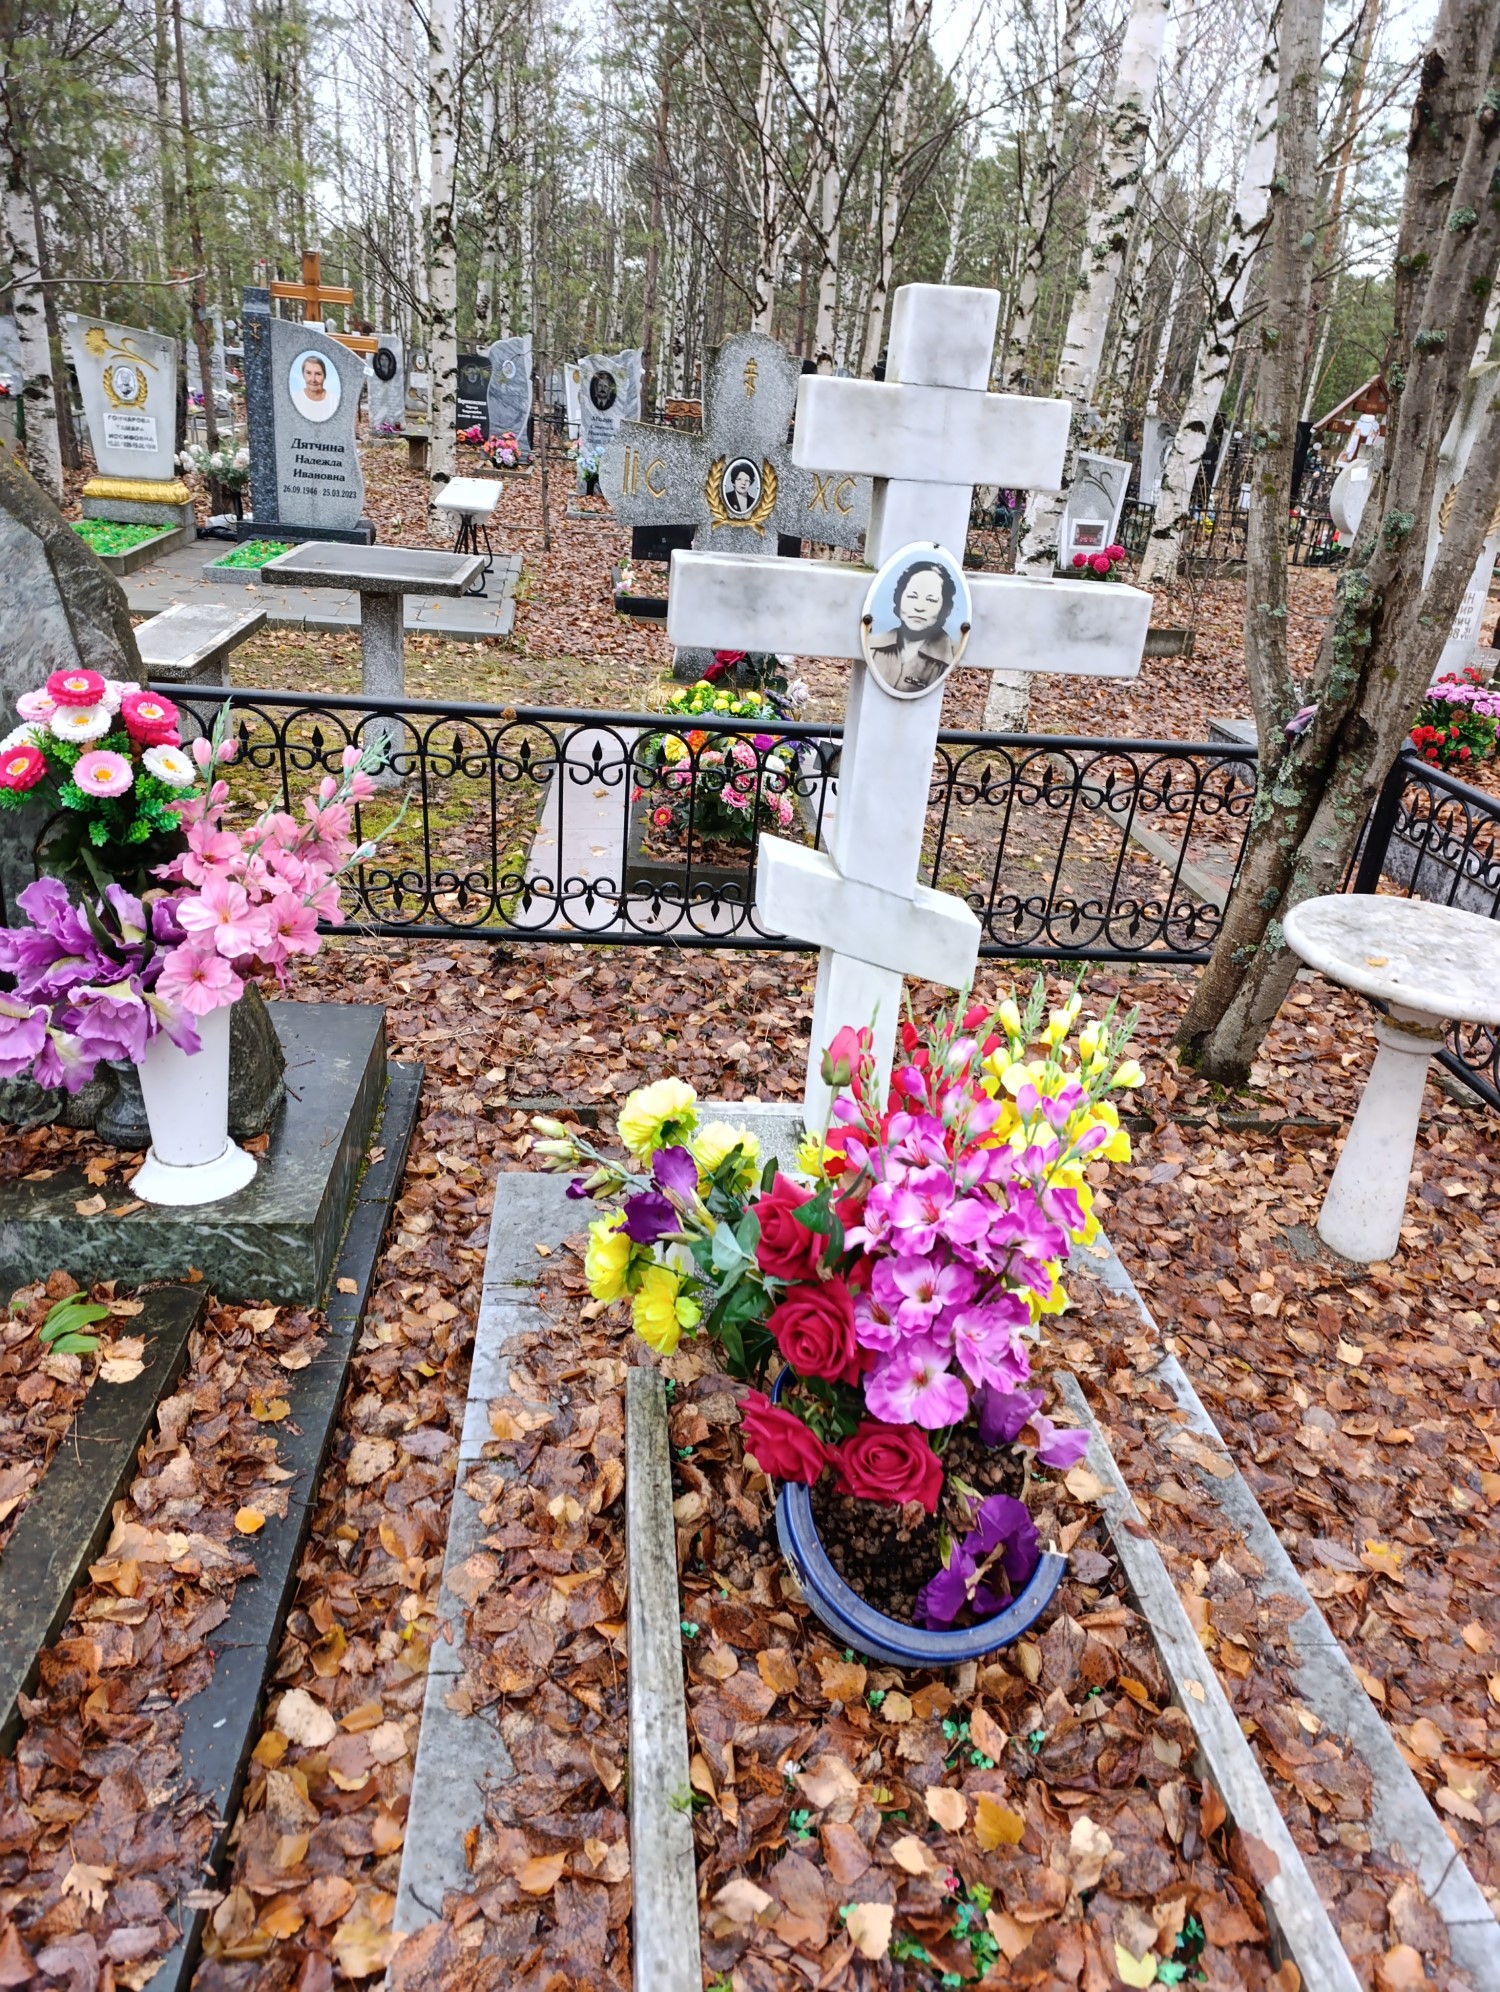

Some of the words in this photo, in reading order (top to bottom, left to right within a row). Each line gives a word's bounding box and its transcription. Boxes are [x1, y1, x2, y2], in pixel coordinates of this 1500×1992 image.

[291, 438, 345, 453] Дятчина
[295, 454, 342, 467] Надежда
[293, 468, 345, 482] Ивановна
[283, 484, 318, 496] 26.09.1946
[322, 488, 357, 499] 25.03.2023
